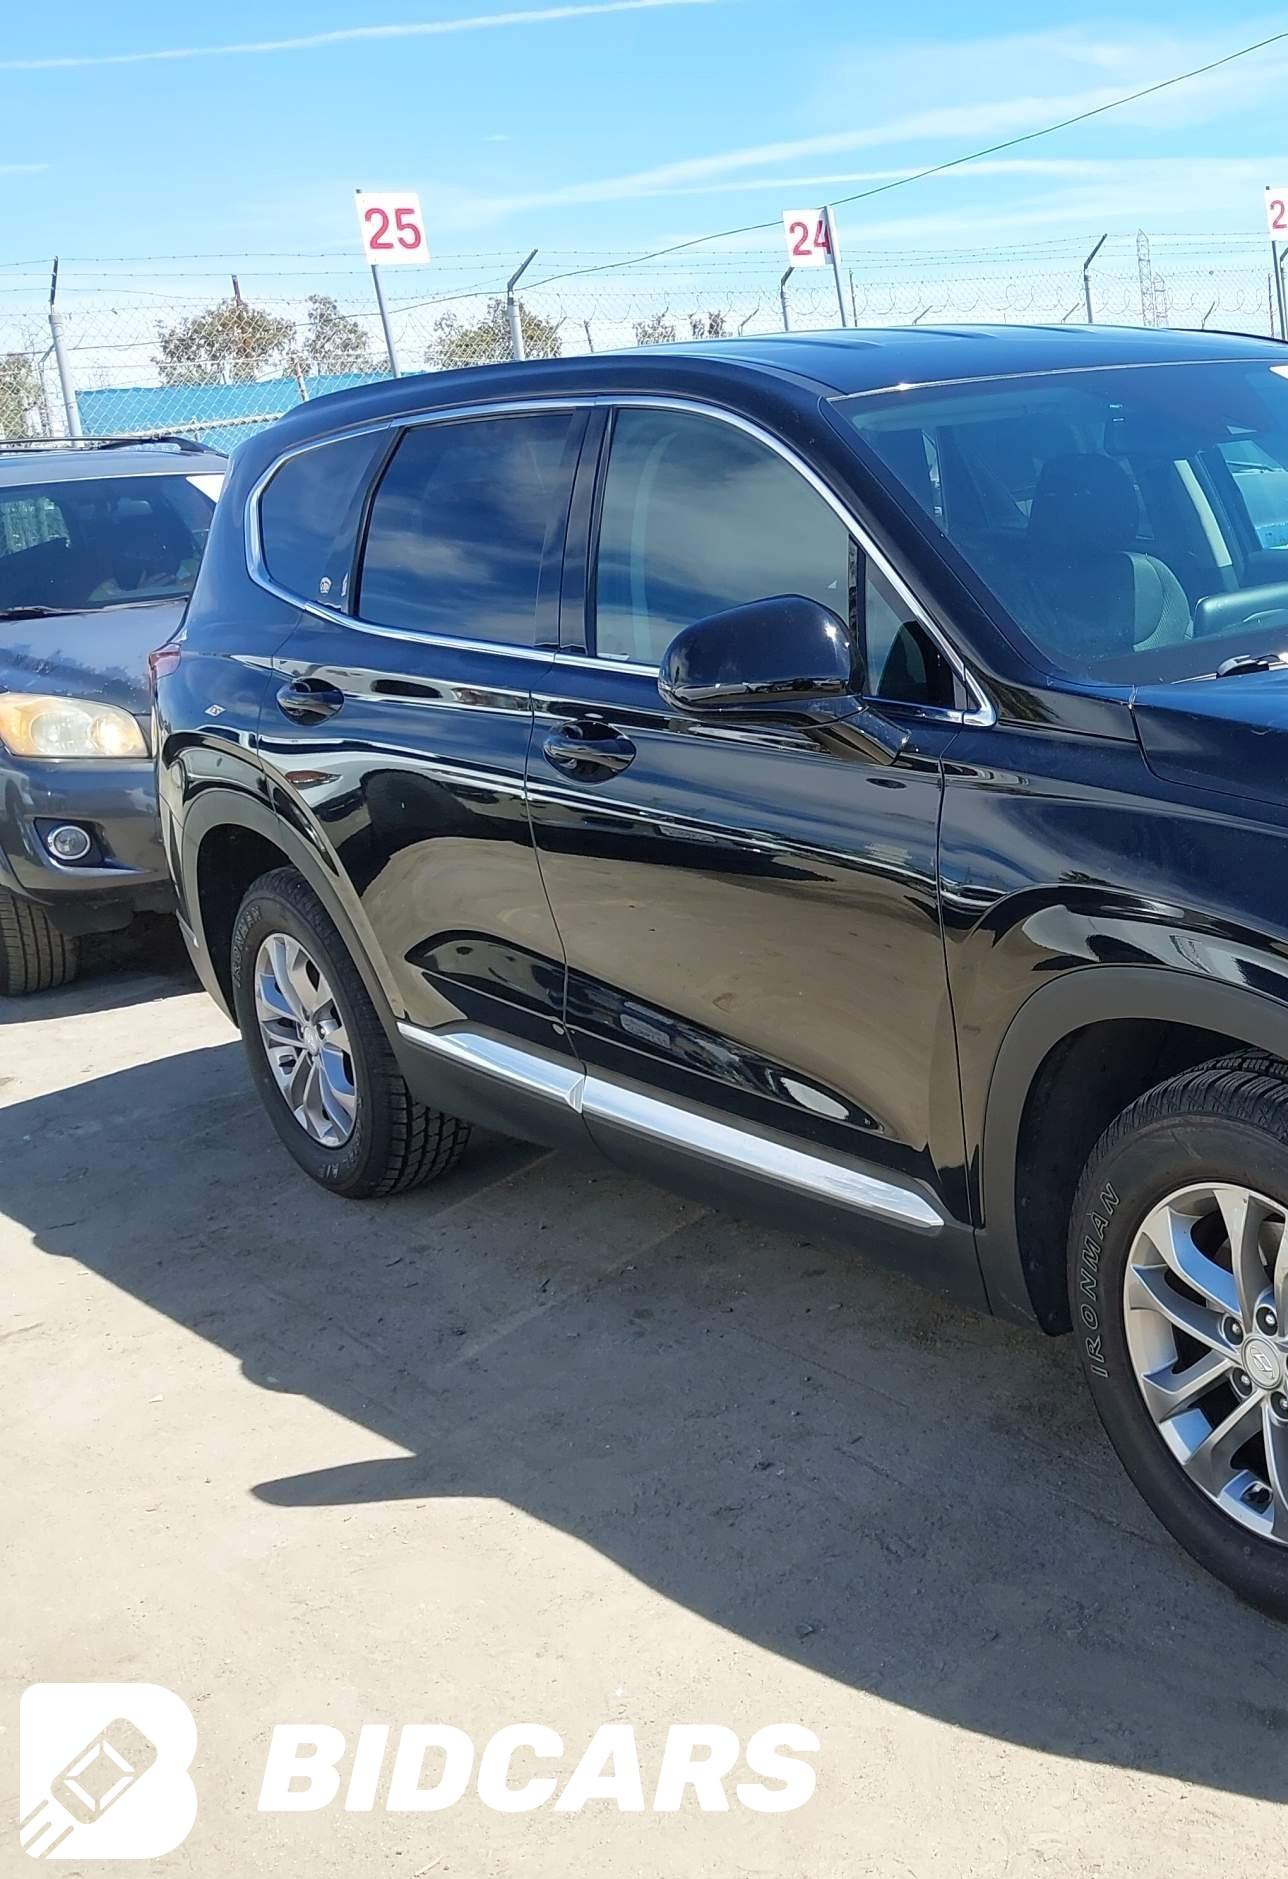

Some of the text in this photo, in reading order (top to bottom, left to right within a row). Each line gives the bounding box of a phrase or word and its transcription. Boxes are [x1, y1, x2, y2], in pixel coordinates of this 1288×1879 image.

[364, 207, 422, 250] 25
[789, 219, 832, 256] 24
[1080, 1182, 1120, 1379] IRONMAN
